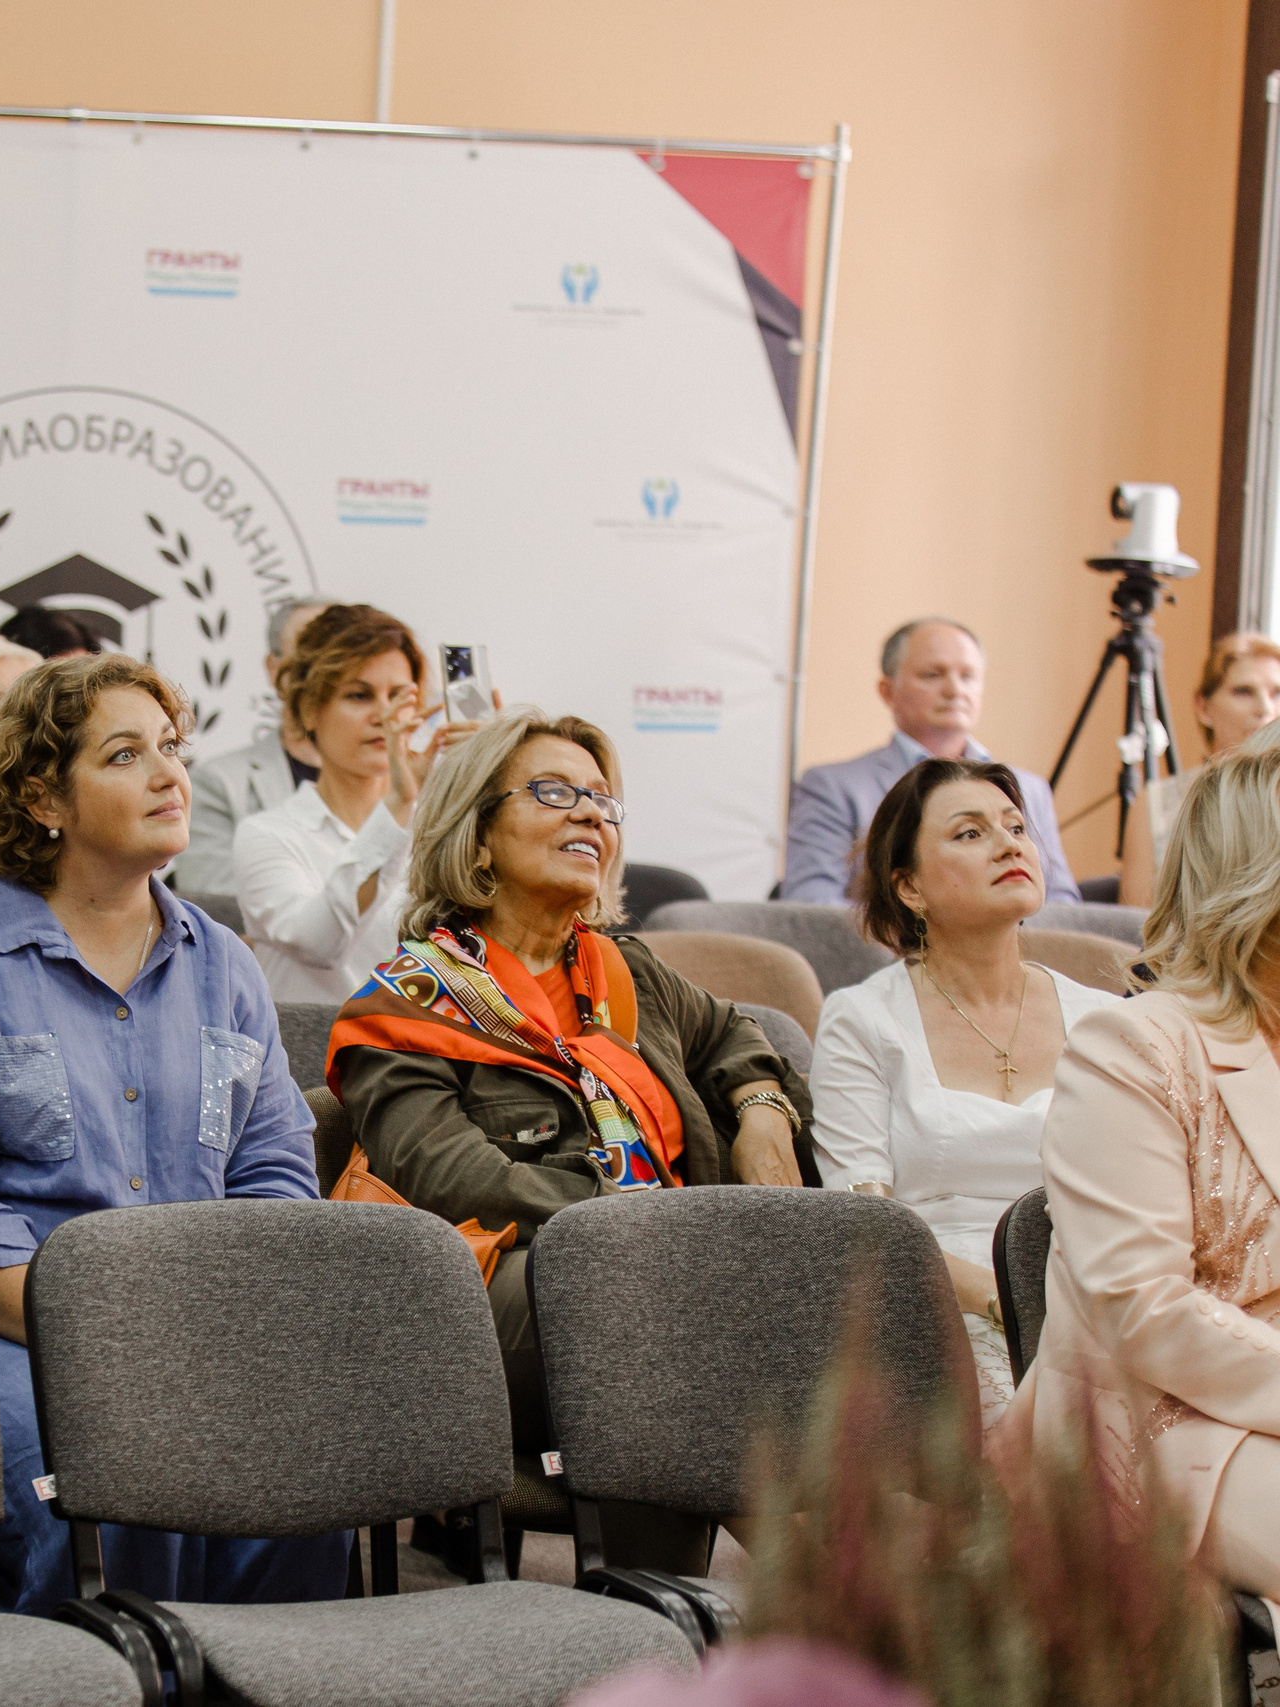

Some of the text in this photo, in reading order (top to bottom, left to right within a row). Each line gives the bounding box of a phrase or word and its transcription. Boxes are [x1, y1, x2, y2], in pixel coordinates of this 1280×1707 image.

[145, 248, 241, 270] ГРАНТЫ
[336, 477, 431, 499] ГРАНТЫ
[632, 685, 724, 707] ГРАНТЫ
